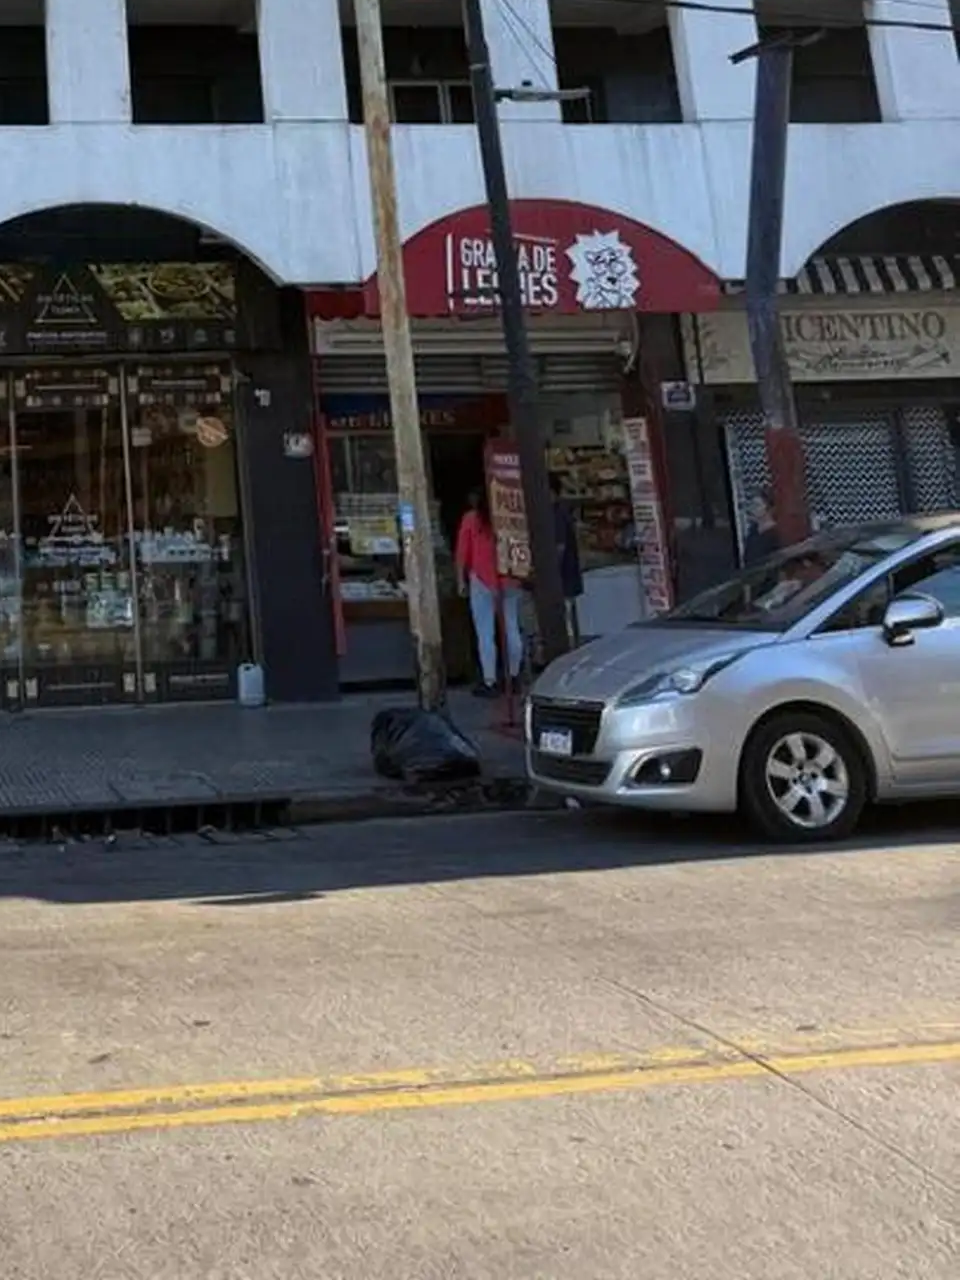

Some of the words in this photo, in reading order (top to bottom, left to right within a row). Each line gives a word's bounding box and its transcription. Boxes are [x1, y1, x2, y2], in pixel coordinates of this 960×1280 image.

[460, 236, 530, 270] GRAA
[533, 245, 557, 273] DE
[783, 310, 947, 343] ICENTINO
